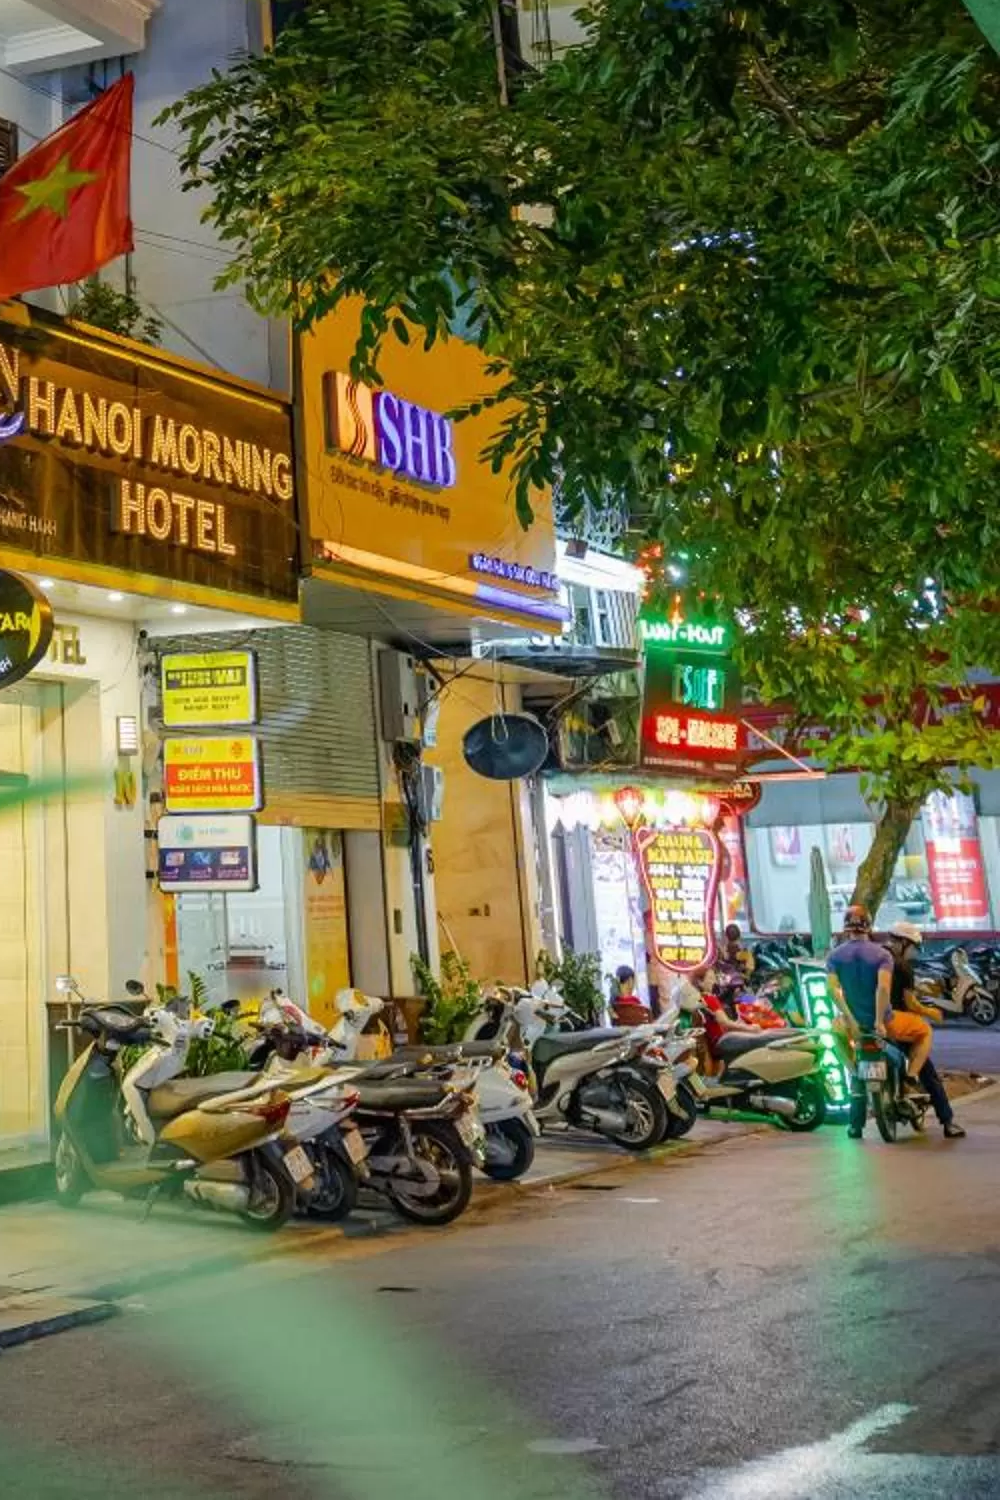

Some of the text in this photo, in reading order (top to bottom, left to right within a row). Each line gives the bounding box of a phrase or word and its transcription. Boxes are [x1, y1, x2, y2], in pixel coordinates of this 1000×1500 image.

[29, 376, 142, 459] HANOI
[151, 413, 294, 501] MORNING
[377, 390, 457, 488] SHB
[120, 479, 237, 557] HOTEL
